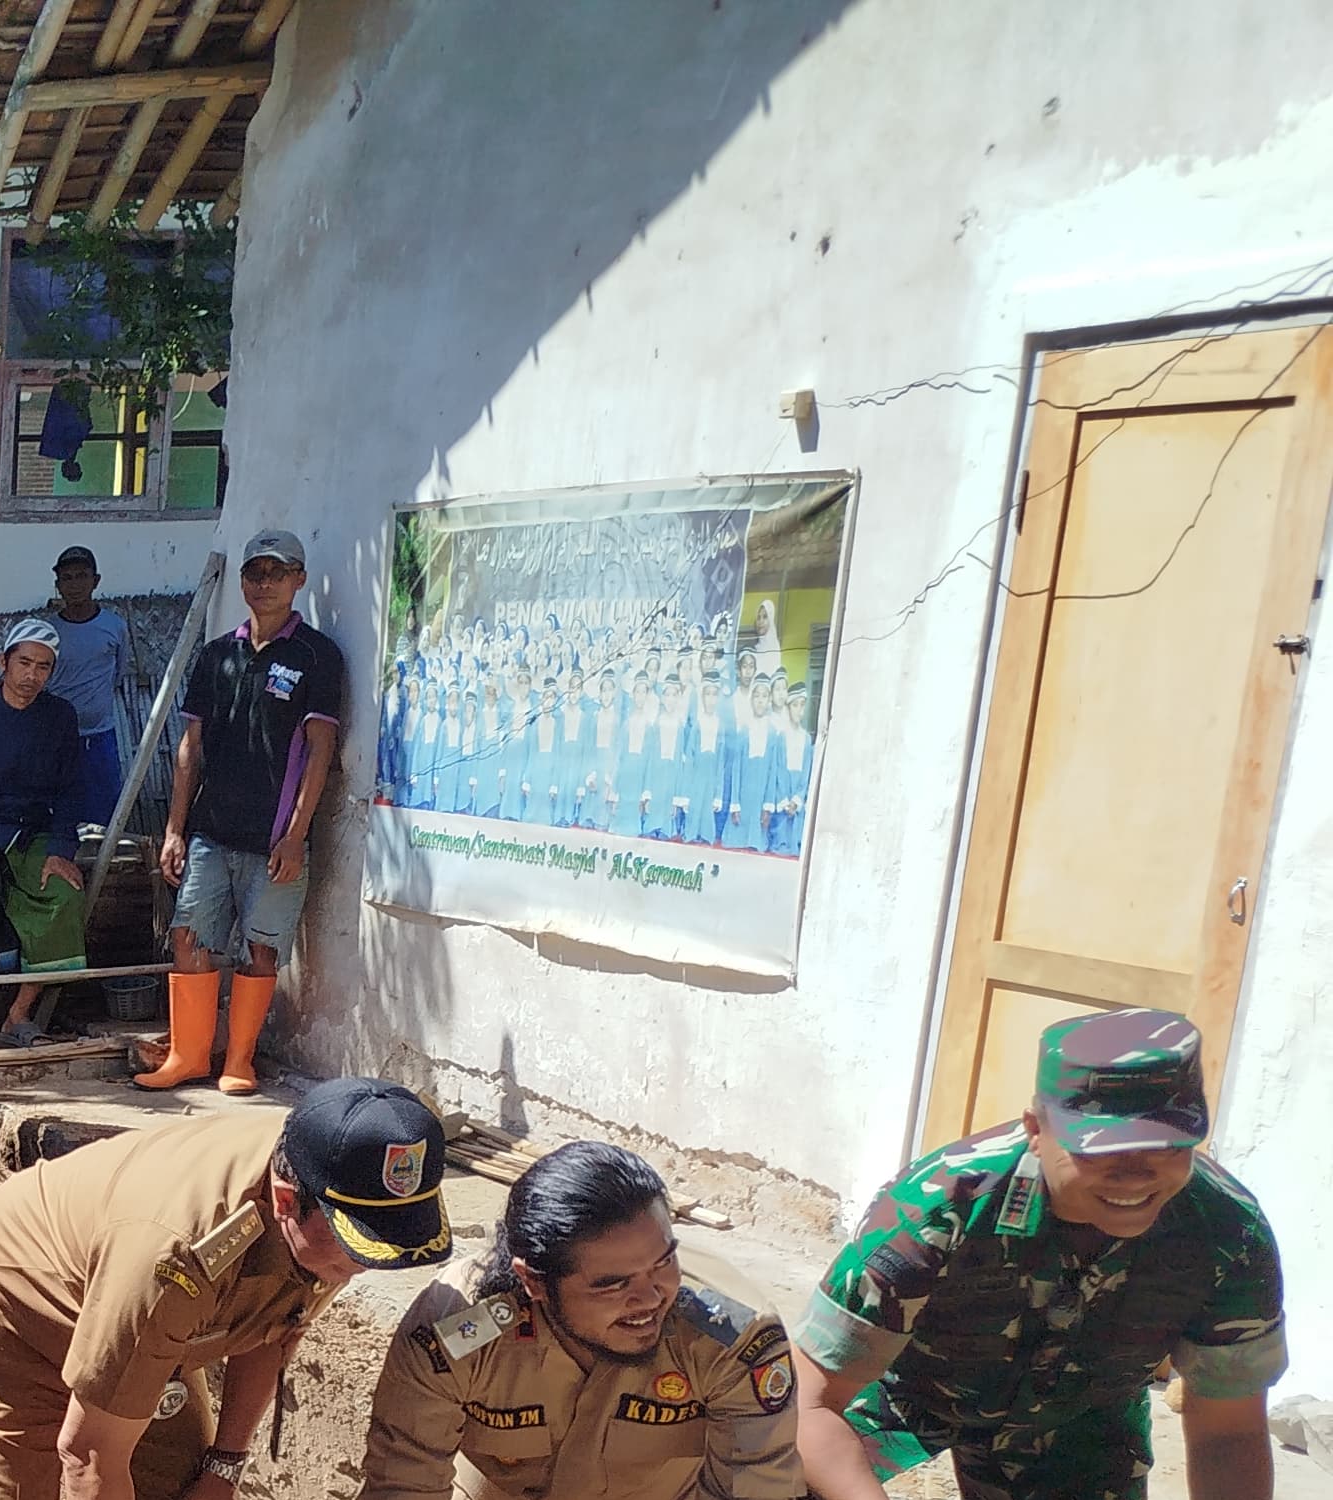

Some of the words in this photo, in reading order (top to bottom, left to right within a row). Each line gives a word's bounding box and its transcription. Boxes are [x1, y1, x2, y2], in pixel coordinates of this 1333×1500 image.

[547, 843, 599, 880] Masjid
[608, 852, 705, 892] Al-Karomah
[519, 1408, 540, 1426] ZM
[627, 1400, 699, 1423] KADES
